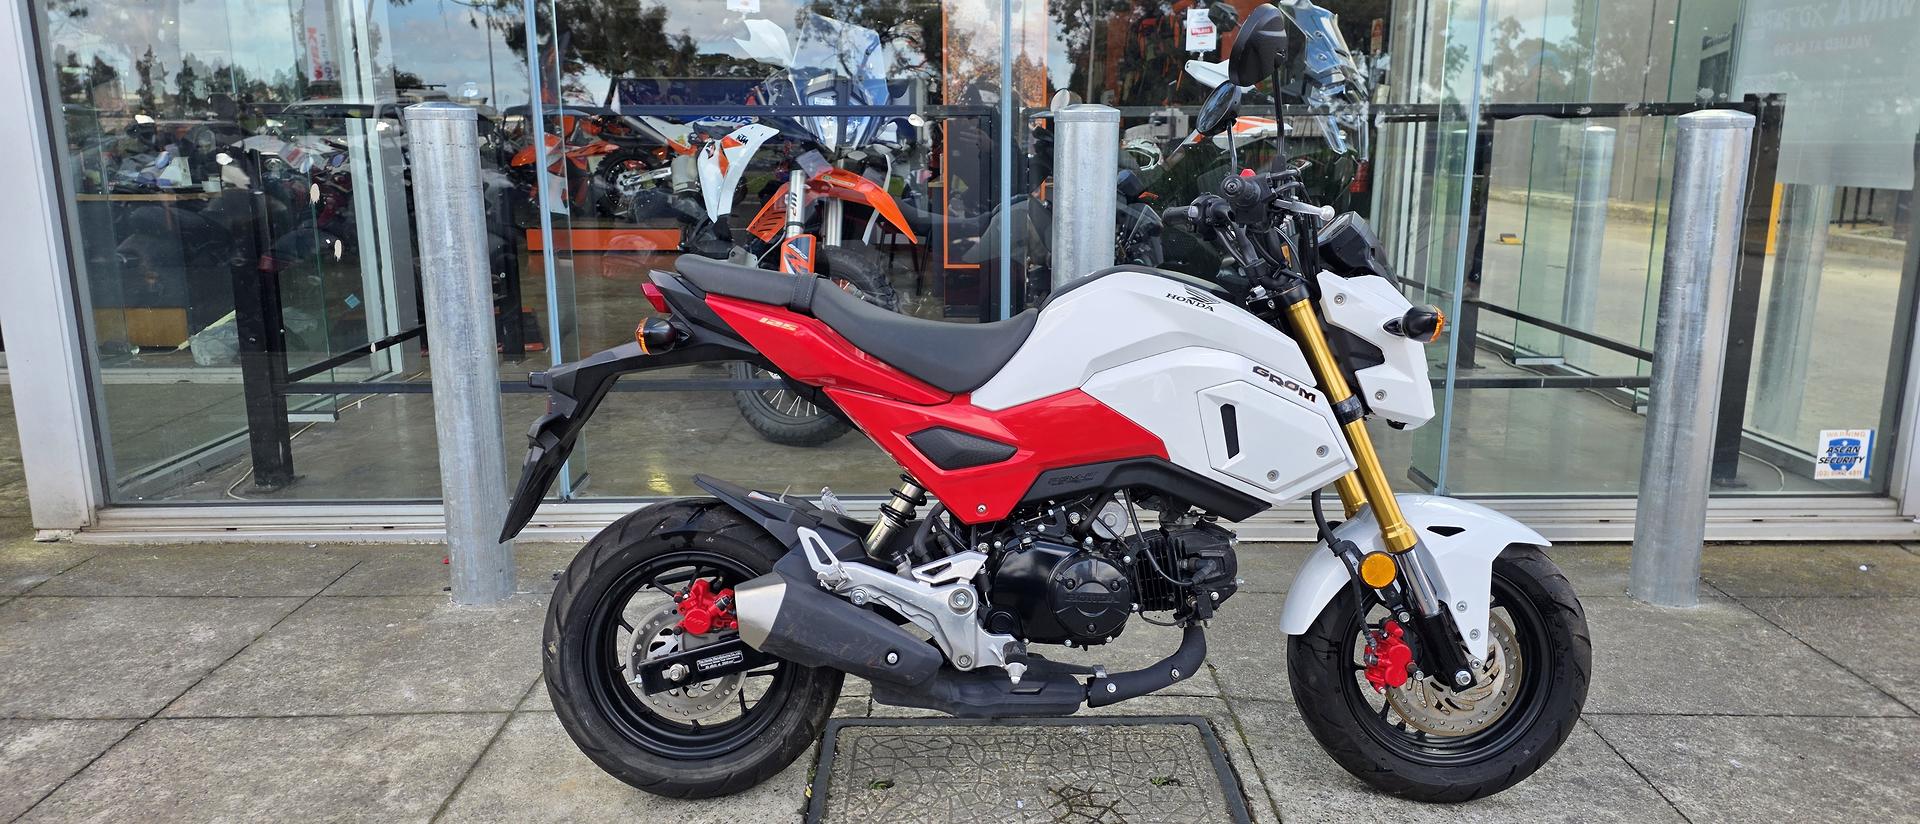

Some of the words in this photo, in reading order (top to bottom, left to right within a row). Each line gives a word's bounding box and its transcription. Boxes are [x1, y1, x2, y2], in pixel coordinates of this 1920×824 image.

[736, 133, 749, 145] KTM
[1165, 293, 1214, 312] HONDA
[759, 317, 799, 331] 125
[1252, 366, 1316, 403] GROM
[1818, 456, 1865, 464] SECURITY
